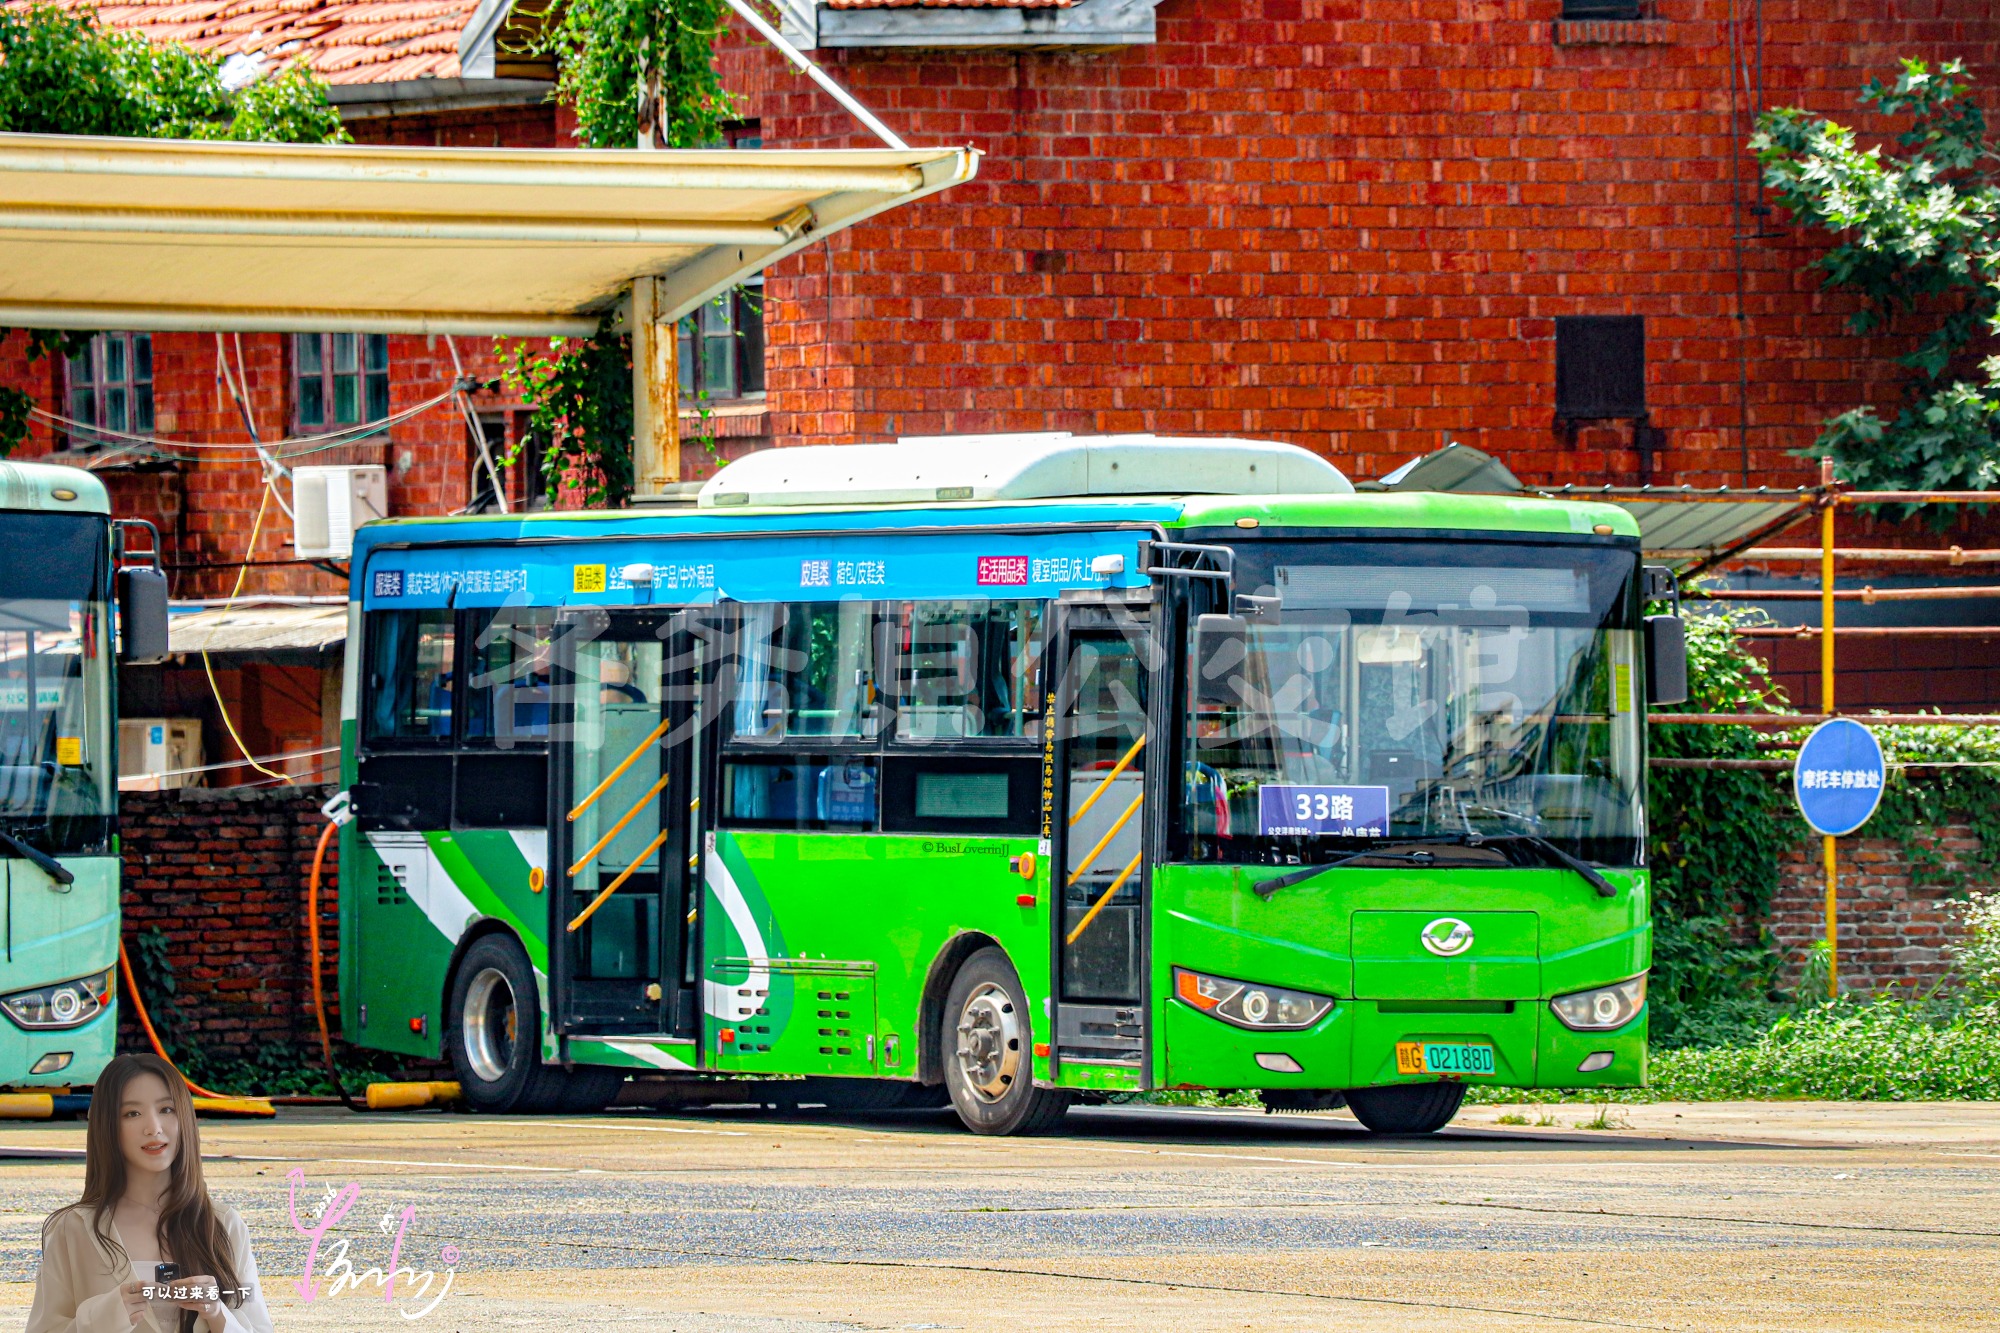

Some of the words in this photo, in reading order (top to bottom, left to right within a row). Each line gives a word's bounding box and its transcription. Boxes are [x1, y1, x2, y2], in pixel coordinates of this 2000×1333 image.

[576, 566, 602, 590] 食品类
[800, 560, 829, 586] 皮具类
[836, 560, 886, 585] 箱包/皮鞋类
[978, 557, 1027, 583] 生活用品类
[375, 571, 402, 597] 服装类
[1802, 768, 1881, 789] 摩托车停放处
[1295, 794, 1354, 821] 33路
[1429, 1046, 1493, 1070] 02188D
